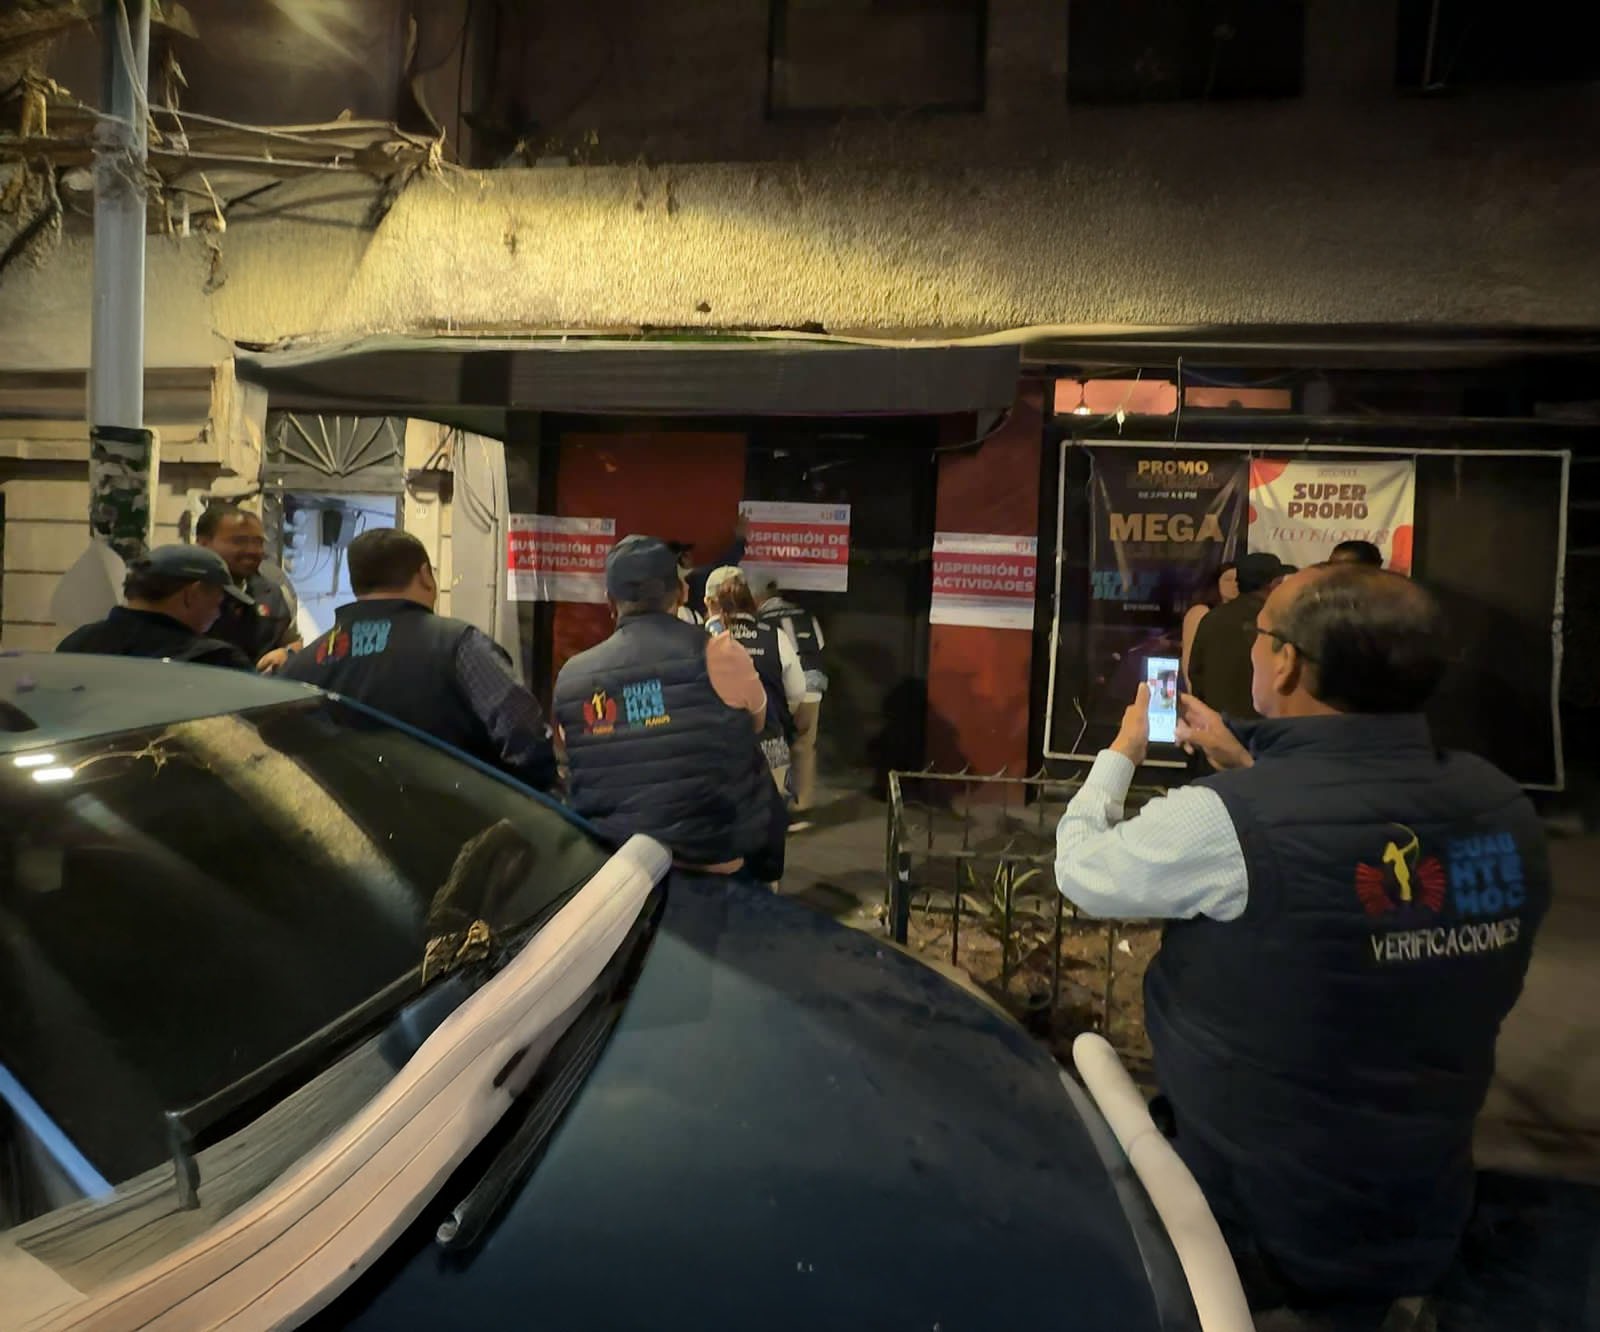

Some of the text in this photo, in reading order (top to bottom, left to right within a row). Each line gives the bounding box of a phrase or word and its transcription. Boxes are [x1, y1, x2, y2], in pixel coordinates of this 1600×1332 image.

[1137, 460, 1209, 475] PROMO
[1293, 483, 1367, 501] SUPER
[1287, 501, 1369, 519] PROMO
[1109, 513, 1225, 542] MEGA
[746, 531, 848, 545] USPENSIÓN DE
[744, 543, 838, 561] ACTIVIDADES
[518, 554, 605, 569] ACTIVIDADES
[933, 561, 1019, 577] USPENSIÓN
[933, 576, 1035, 592] ACTIVIDADES
[1371, 917, 1520, 961] VERIFICACIONES
